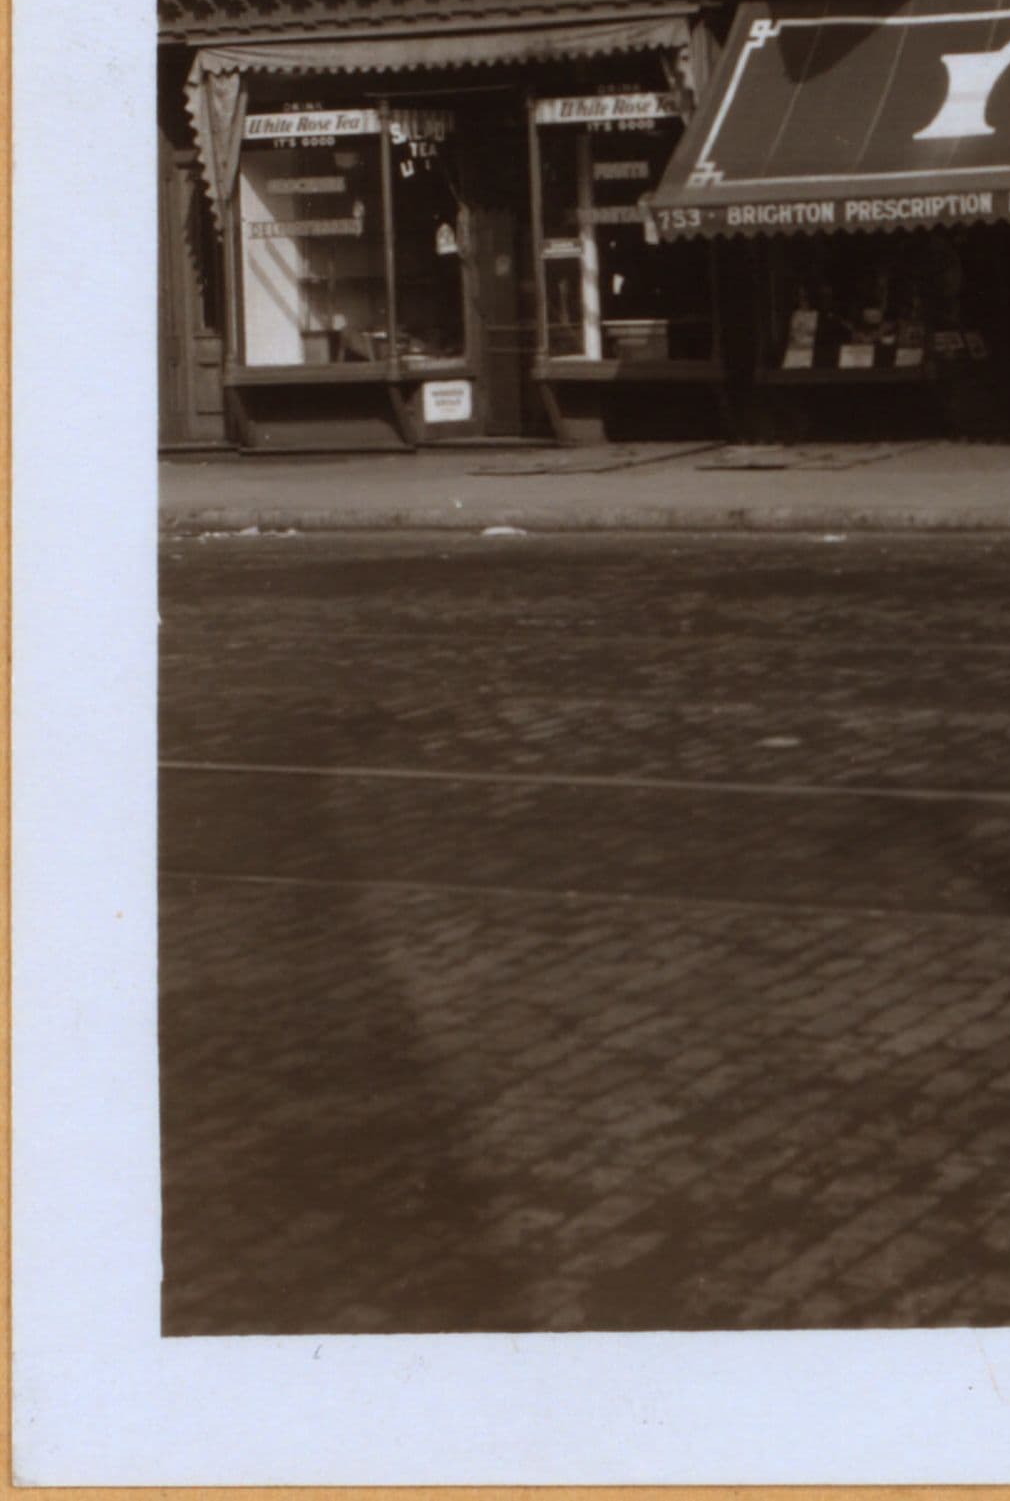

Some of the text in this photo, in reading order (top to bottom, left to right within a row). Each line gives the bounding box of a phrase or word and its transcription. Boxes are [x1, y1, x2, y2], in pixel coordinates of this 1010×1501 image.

[561, 100, 607, 117] White
[612, 97, 651, 116] Rose
[250, 114, 361, 134] White Rose Tea
[618, 118, 656, 131] GOOD
[301, 136, 336, 147] GOOD
[409, 141, 438, 158] TEA
[657, 208, 701, 230] 753
[727, 201, 835, 227] BRIGHTON
[845, 191, 993, 222] PRESCRIPTION
